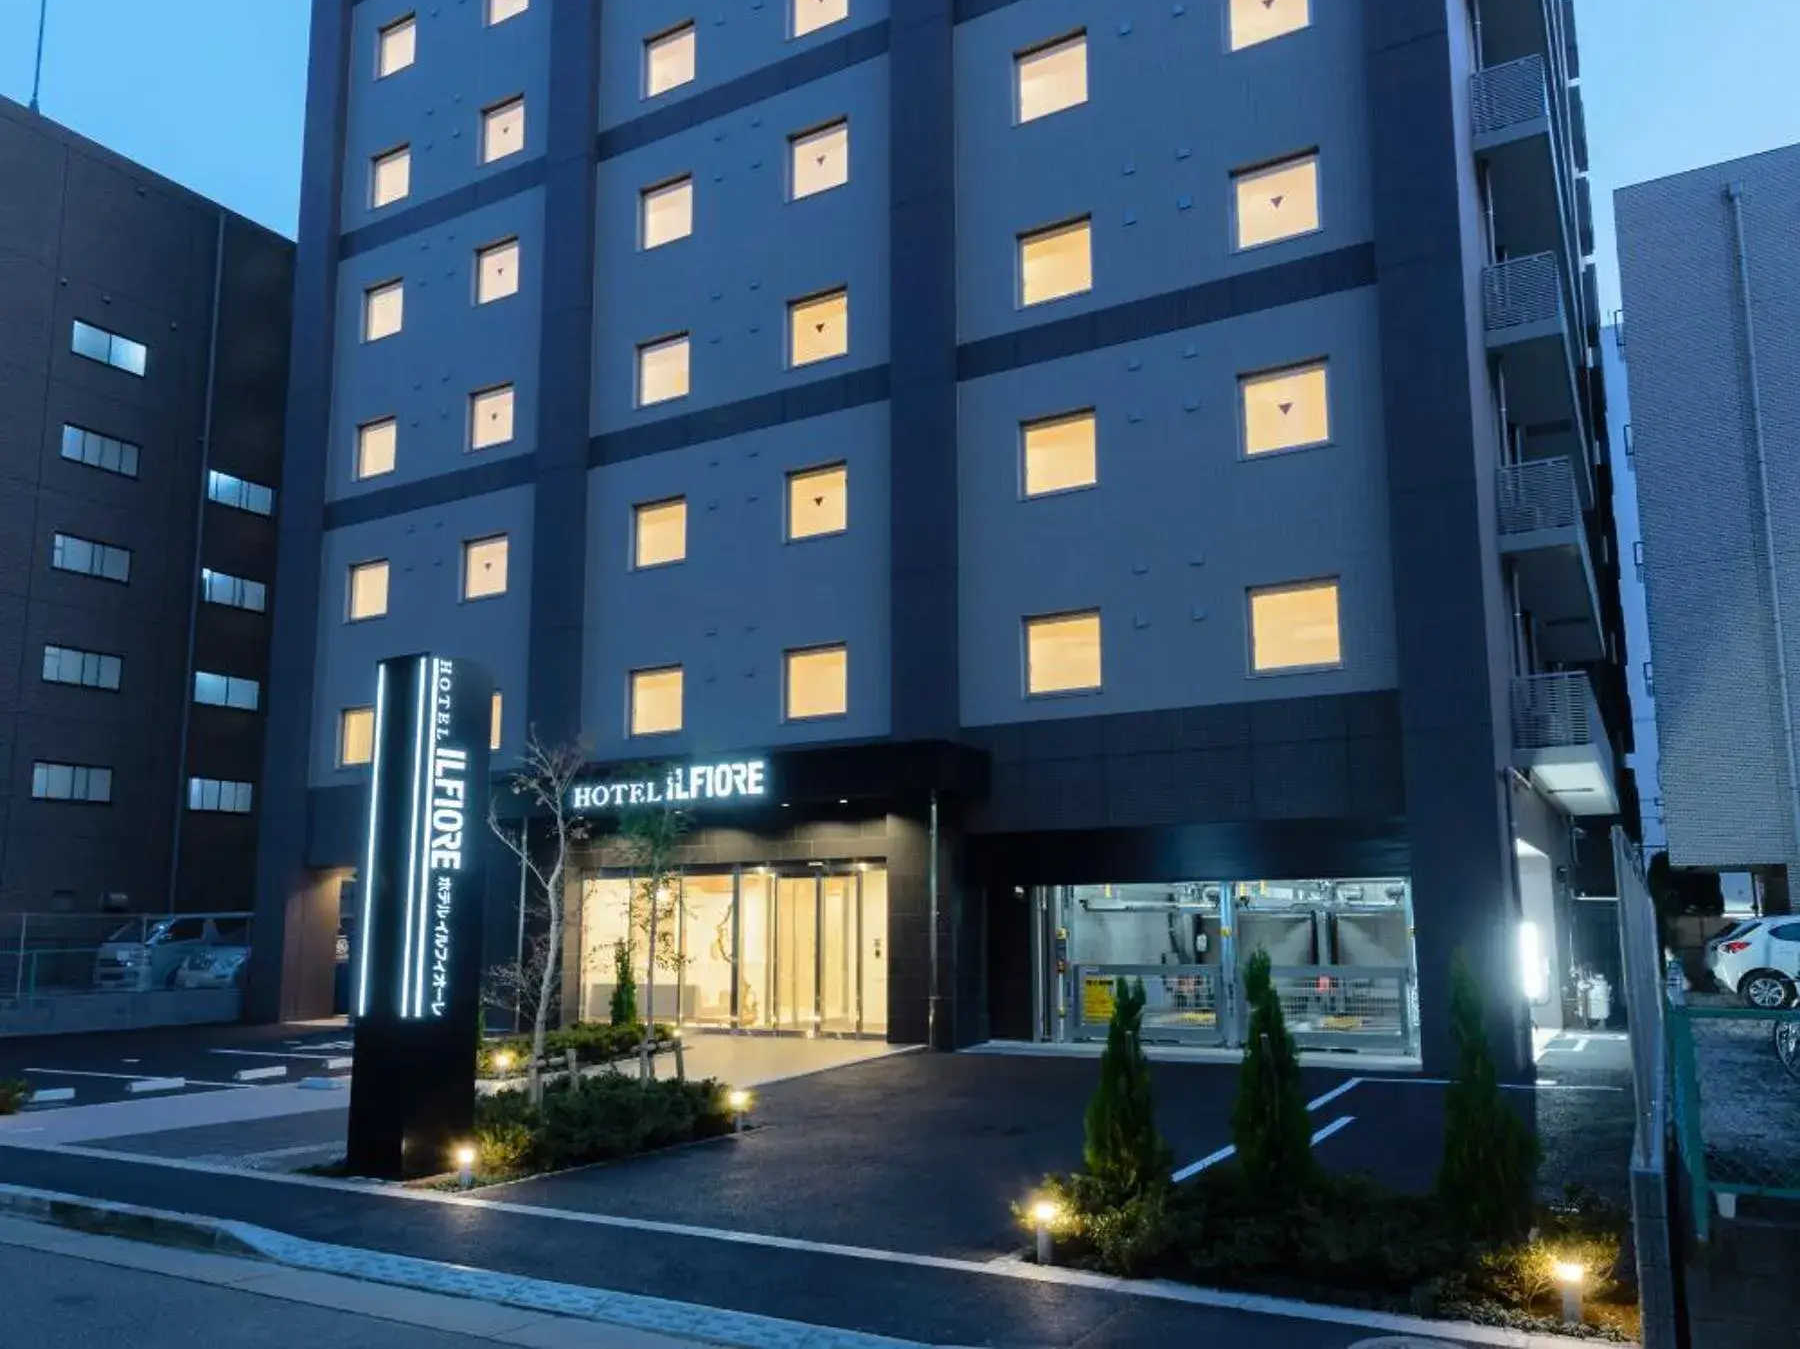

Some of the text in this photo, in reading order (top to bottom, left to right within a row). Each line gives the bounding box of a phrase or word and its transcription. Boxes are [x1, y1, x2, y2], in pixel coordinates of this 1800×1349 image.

[431, 659, 467, 870] HOTEL ILFIORE
[573, 782, 663, 808] HOTEL
